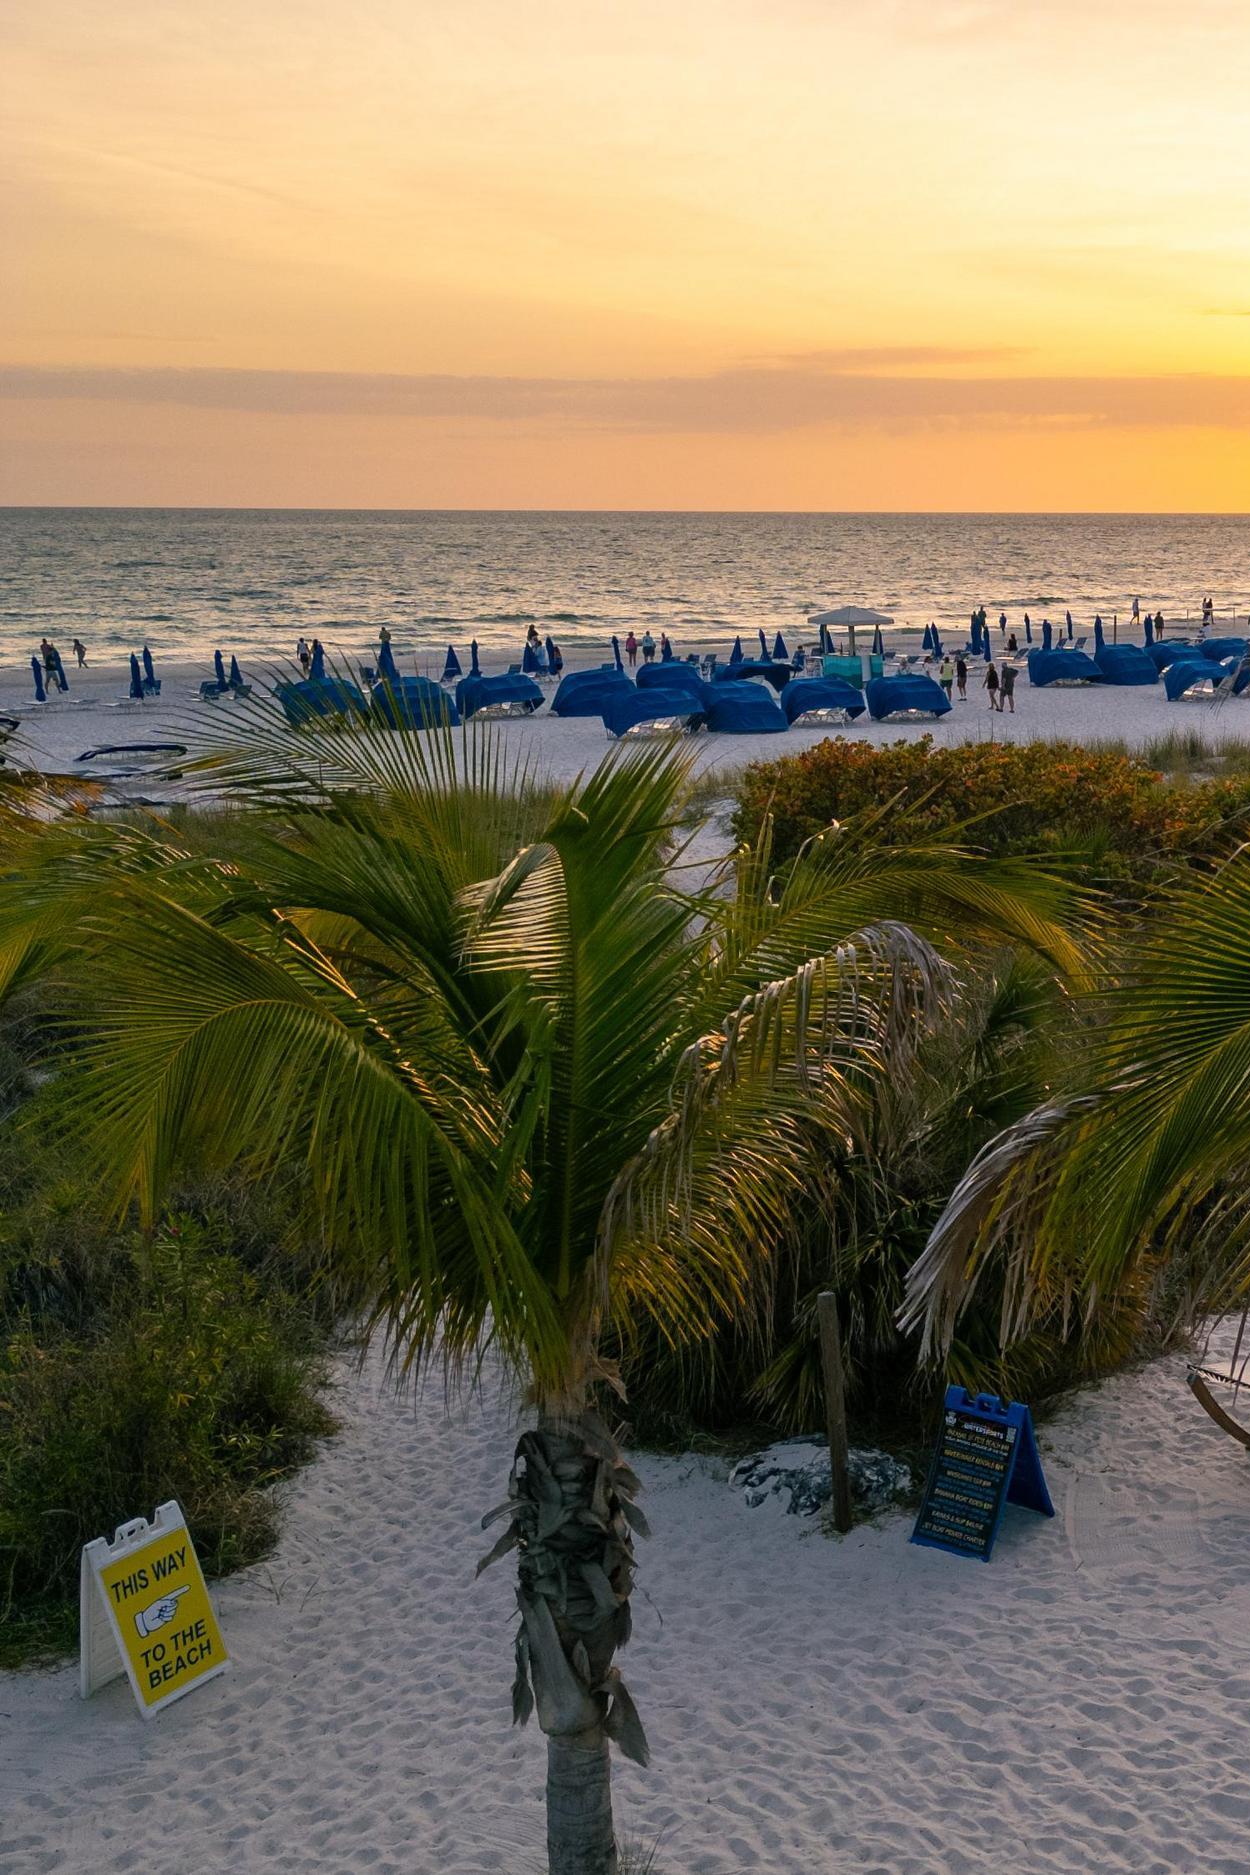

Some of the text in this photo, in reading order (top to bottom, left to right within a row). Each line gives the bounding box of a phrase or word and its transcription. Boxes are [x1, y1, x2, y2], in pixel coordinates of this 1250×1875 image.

[111, 1546, 187, 1603] THIS WAY
[140, 1618, 207, 1668] TO THE
[148, 1638, 213, 1689] BEACH
